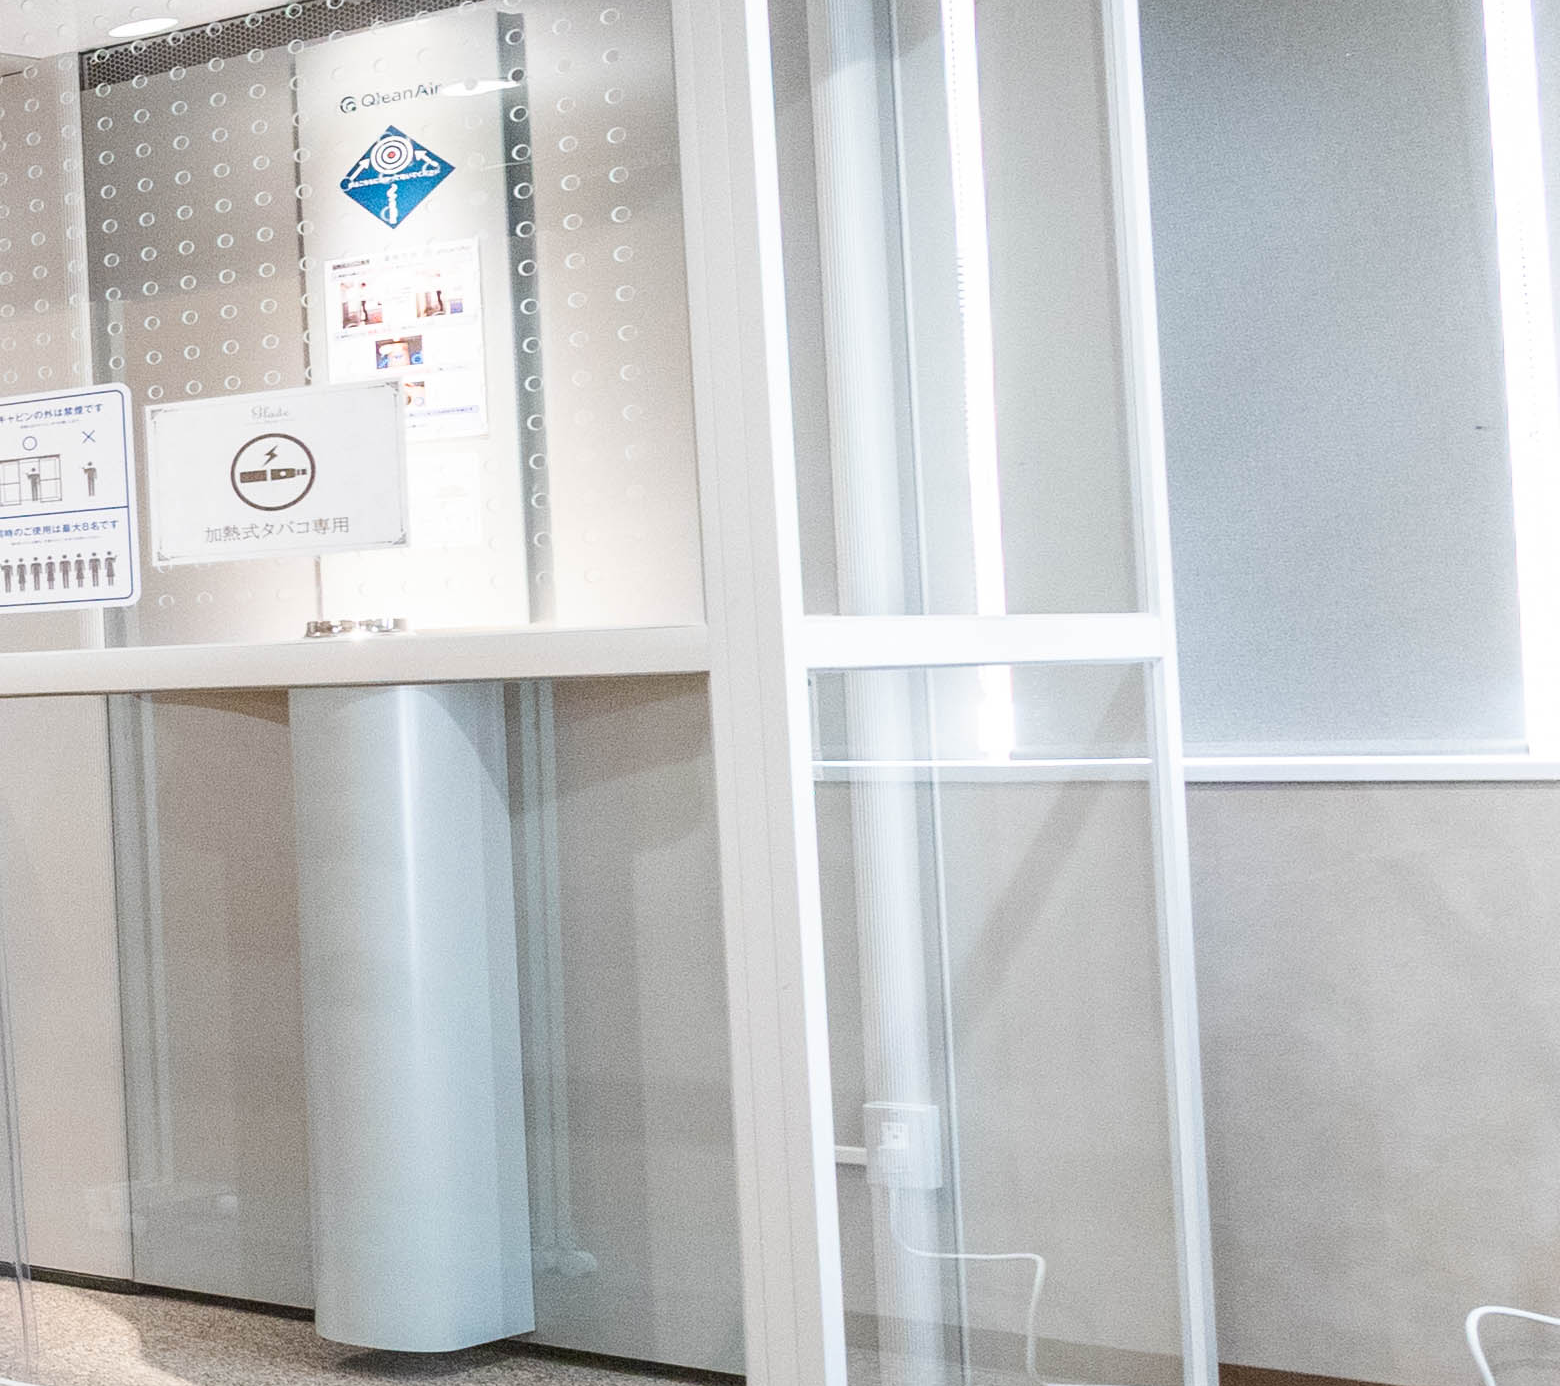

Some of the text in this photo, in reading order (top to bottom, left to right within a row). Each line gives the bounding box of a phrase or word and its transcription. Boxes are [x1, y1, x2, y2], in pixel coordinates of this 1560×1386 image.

[361, 82, 441, 107] QleanAir
[205, 516, 349, 543] 加熱式タバコ専用
